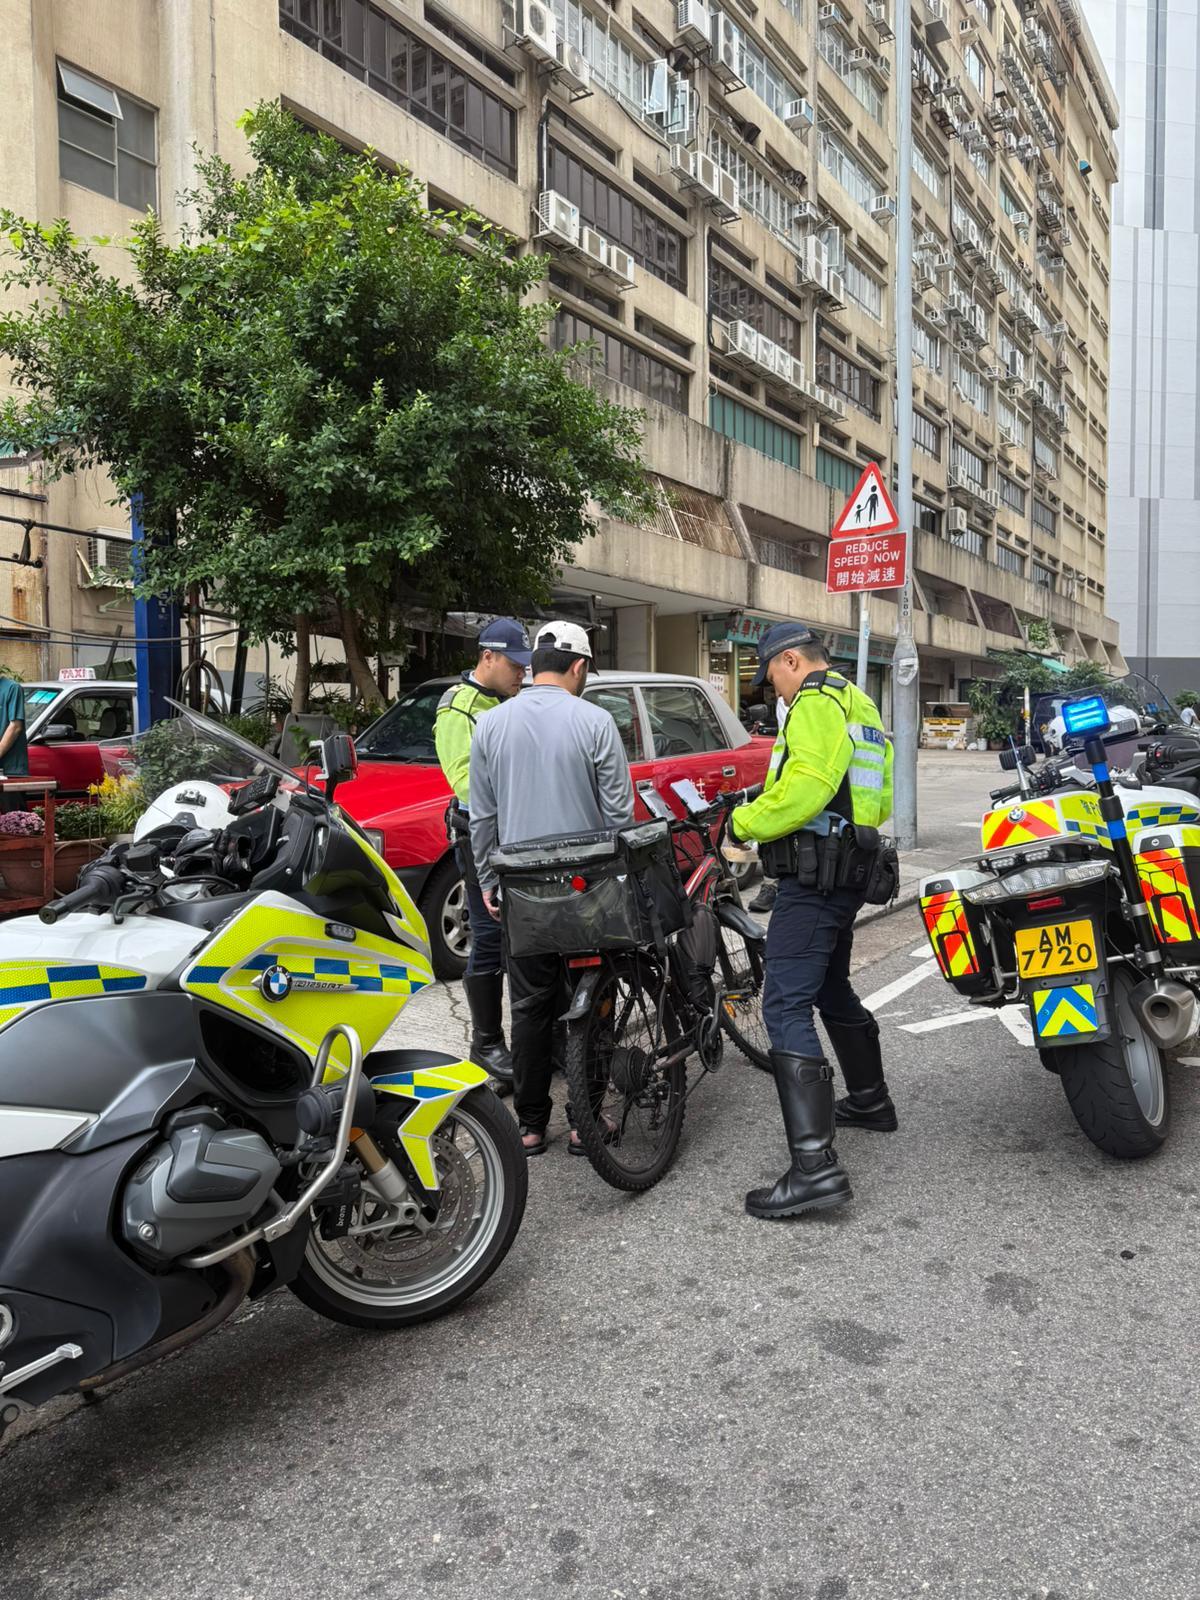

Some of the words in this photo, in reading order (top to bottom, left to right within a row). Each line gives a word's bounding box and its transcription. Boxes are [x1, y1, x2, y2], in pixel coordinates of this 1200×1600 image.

[845, 540, 889, 554] REDUCE
[834, 555, 868, 568] SPEED
[874, 550, 901, 563] NOW
[836, 567, 896, 587] 開始減速
[61, 669, 86, 679] TAXI
[1039, 925, 1072, 950] AM
[1022, 943, 1092, 971] 7720
